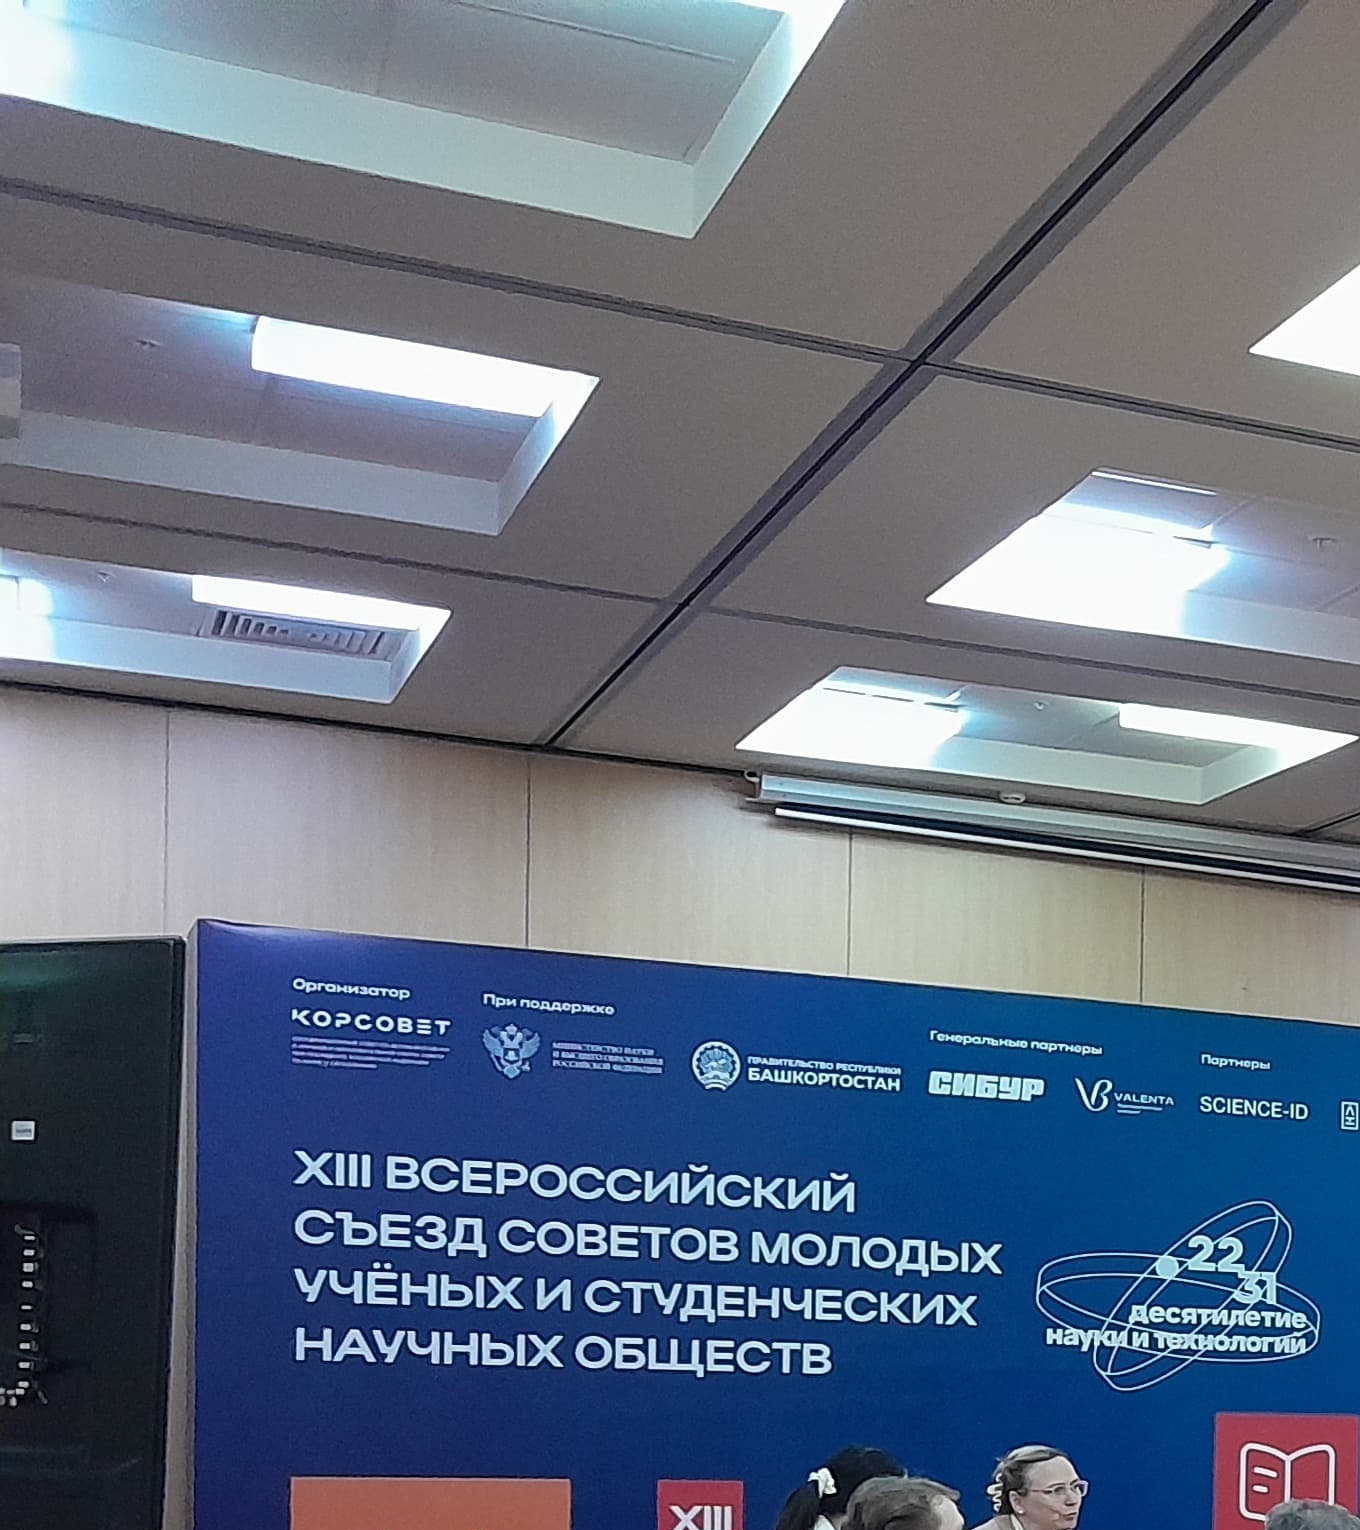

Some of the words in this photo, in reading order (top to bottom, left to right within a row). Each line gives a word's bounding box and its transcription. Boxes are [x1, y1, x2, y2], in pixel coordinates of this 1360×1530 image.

[292, 978, 410, 1000] Организатор
[483, 993, 518, 1008] При
[291, 1008, 451, 1035] КОРСОВЕТ
[930, 1030, 1028, 1049] Генеральные
[747, 1056, 834, 1070] ПРАВИТЕЛЬСТВО
[1201, 1053, 1270, 1072] Партнеры
[748, 1067, 901, 1091] БАШКОРТОСТАН
[928, 1070, 1045, 1101] СИБУР
[1114, 1092, 1175, 1106] VALENTA
[1199, 1096, 1308, 1120] SCIENCE-ID
[292, 1150, 371, 1188] XIII
[386, 1155, 855, 1213] ВСЕРОССИЙСКИЙ
[294, 1209, 487, 1258] СЪЕЗД
[499, 1219, 739, 1262] СОВЕТОВ
[751, 1231, 1002, 1277] МОЛОДЫХ
[294, 1262, 524, 1310] УЧЁНЫХ
[536, 1277, 571, 1311] И
[585, 1280, 978, 1326] СТУДЕНЧЕСКИХ
[1128, 1304, 1307, 1329] десятилетие
[295, 1327, 564, 1368] НАУЧНЫХ
[575, 1335, 833, 1377] ОБЩЕСТВ
[1046, 1327, 1128, 1351] науки
[1131, 1332, 1150, 1349] и
[1153, 1331, 1307, 1354] технологий
